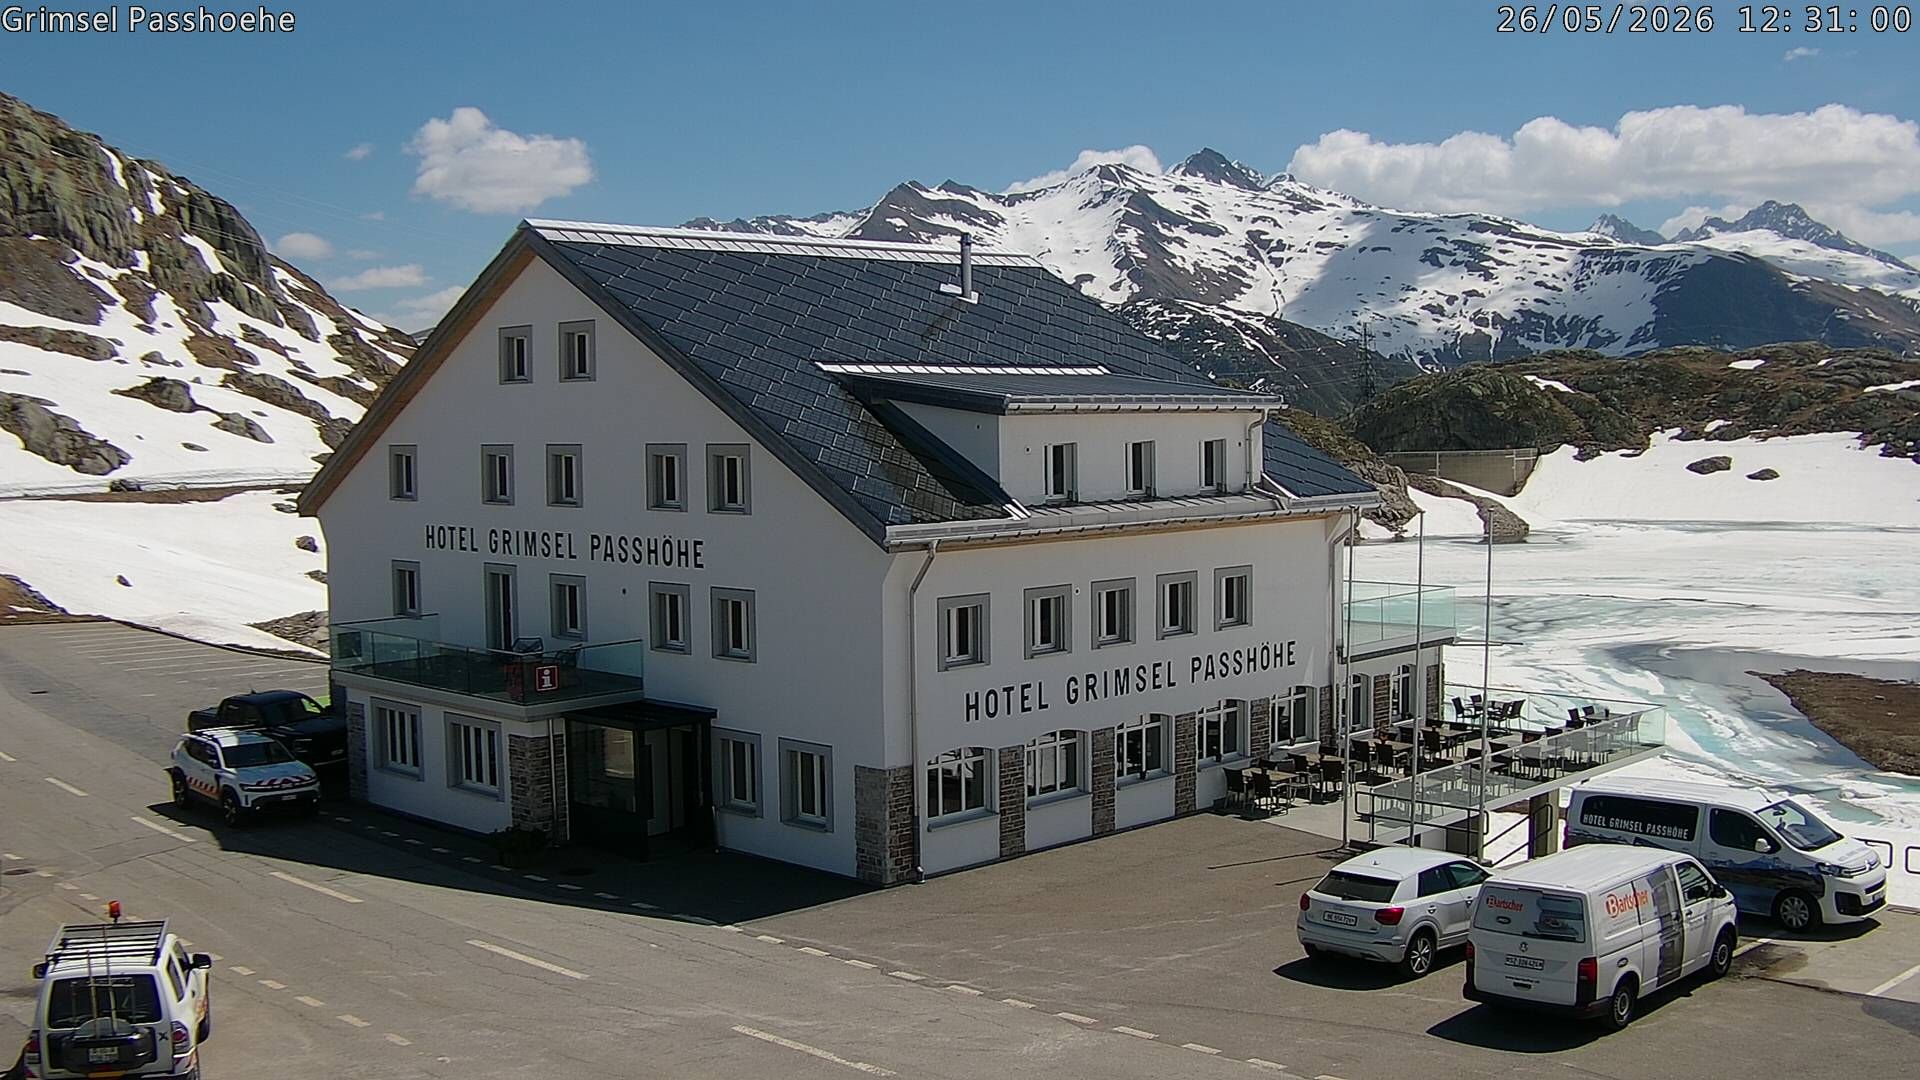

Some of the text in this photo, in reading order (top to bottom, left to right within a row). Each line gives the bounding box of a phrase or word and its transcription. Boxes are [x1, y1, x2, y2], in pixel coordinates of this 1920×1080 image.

[425, 524, 705, 569] HOTEL GRIMSEL PASSHÖHE
[964, 640, 1297, 723] HOTEL GRIMSEL PASSHÖHE
[1583, 814, 1606, 827] HOTEL
[1609, 817, 1643, 833] GRIMSEL
